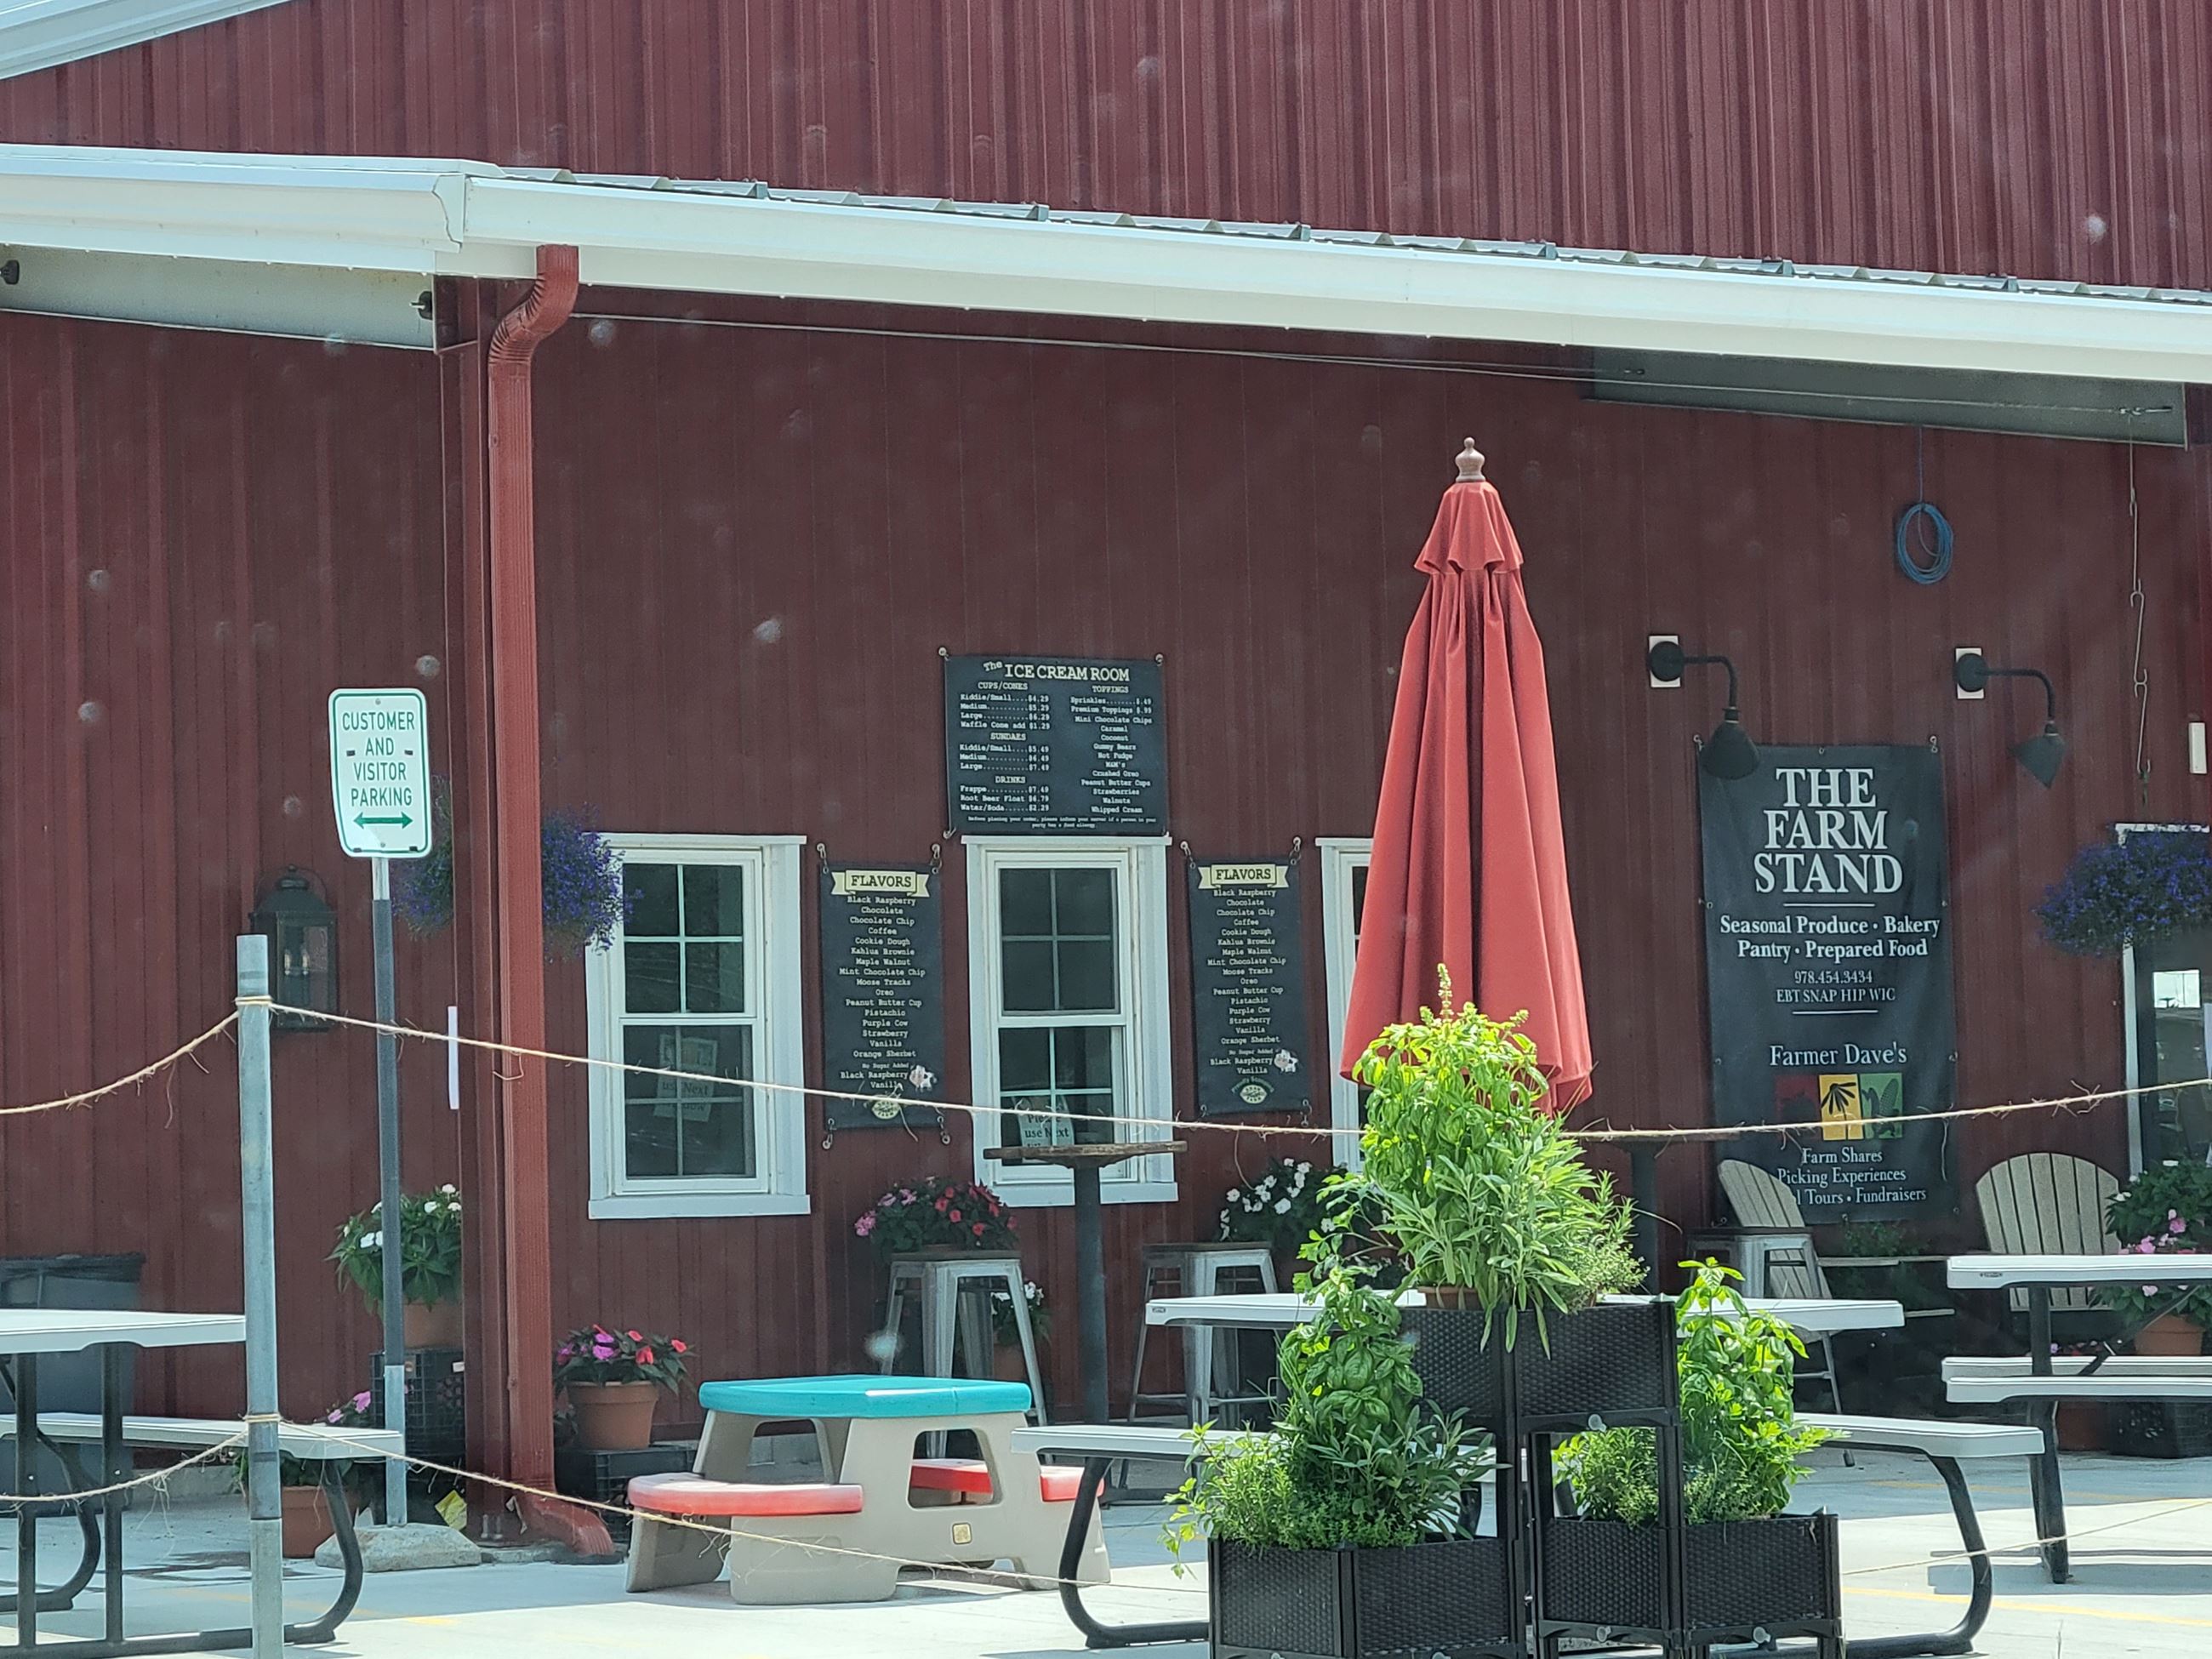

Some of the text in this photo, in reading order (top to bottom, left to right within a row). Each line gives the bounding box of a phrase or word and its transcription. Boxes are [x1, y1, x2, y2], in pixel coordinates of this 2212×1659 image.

[983, 661, 1130, 681] The ICE CREAM ROOM
[978, 681, 1028, 691] CUPS/CONES
[1092, 685, 1129, 693] TOPPINGS
[1102, 706, 1133, 715] Toppings
[342, 711, 415, 731] CUSTOMER
[1029, 721, 1051, 730] $1.29
[1132, 716, 1153, 726] Chips
[989, 732, 1027, 740] SUNDAES
[365, 737, 394, 756] AND
[1093, 743, 1114, 751] Gummy
[1114, 752, 1133, 761] Fudge
[353, 761, 407, 781] VISITOR
[995, 775, 1026, 784] DRINKS
[1134, 779, 1151, 788] Cups
[1776, 767, 1876, 807] THE
[351, 787, 413, 807] PARKING
[1028, 795, 1049, 803] $6.79
[1091, 806, 1120, 814] Whipped
[1763, 809, 1888, 849] FARM
[1216, 868, 1271, 881] FLAVORS
[1753, 853, 1903, 893] STAND
[851, 875, 911, 887] FLAVORS
[1238, 889, 1276, 898] Raspberry
[875, 896, 916, 906] Raspberry
[1216, 908, 1275, 916] Chocolate Chip
[849, 916, 915, 926] Chocolate Chip
[868, 926, 898, 935] Coffee
[1719, 915, 1941, 938] Seasonal Produce Bakery
[1251, 927, 1272, 936] Dough
[887, 938, 911, 947] Dough
[1222, 948, 1245, 956] Maple
[1737, 938, 1929, 964] Pantry Prepared Food
[855, 957, 880, 966] Maple
[1229, 957, 1267, 966] Chocolate
[1269, 956, 1286, 965] Chip
[863, 967, 905, 976] Chocolate
[908, 968, 926, 978] Chip
[1794, 970, 1873, 984] 978.454.3434
[875, 988, 894, 996] Oreo
[1270, 986, 1284, 995] Cup
[1776, 988, 1896, 1003] EBT SNAP HIP WIC
[909, 999, 922, 1008] Cup
[1229, 1006, 1255, 1016] Purple
[862, 1018, 891, 1028] Purple
[1229, 1017, 1271, 1025] Strawberry
[862, 1029, 909, 1038] Strawberry
[1235, 1025, 1266, 1034] Vanilla
[869, 1039, 903, 1047] Vanilla
[852, 1050, 882, 1058] Orange
[1770, 1041, 1907, 1065] Farmer Dave's
[1234, 1057, 1274, 1065] Raspberry
[840, 1070, 909, 1080] Black Raspberry
[869, 1080, 903, 1089] Vanill
[1024, 1129, 1043, 1138] use
[1801, 1146, 1884, 1164] Farm Shares
[1777, 1166, 1907, 1189] Picking Experiences
[1804, 1189, 1844, 1205] Tours
[1855, 1186, 1927, 1204] Fundraisers
